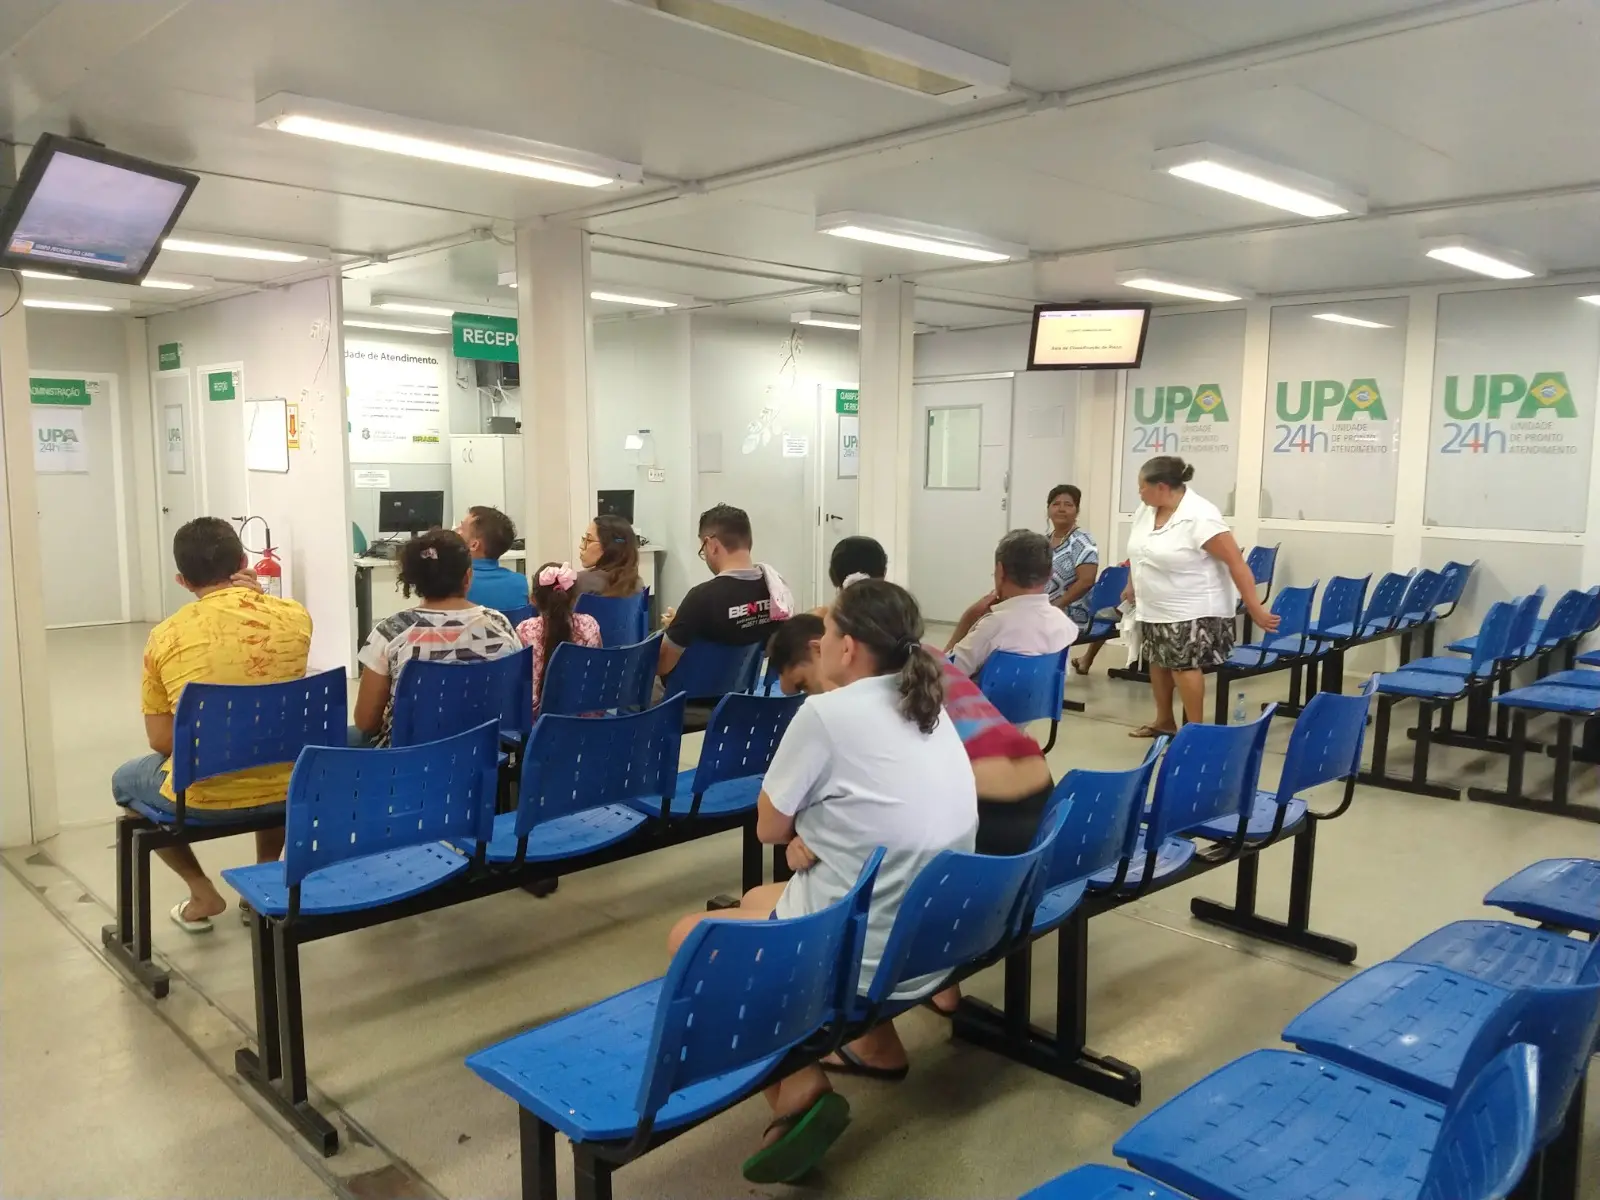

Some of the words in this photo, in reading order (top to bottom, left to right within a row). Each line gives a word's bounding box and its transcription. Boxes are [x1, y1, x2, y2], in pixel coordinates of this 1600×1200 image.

[463, 328, 519, 346] RECEP
[367, 351, 379, 360] de
[380, 352, 439, 365] Atendimento.
[1276, 378, 1388, 422] UPA
[1443, 371, 1579, 420] UPA
[1134, 383, 1229, 425] UPA
[1331, 423, 1368, 432] UNIDADE
[1510, 421, 1553, 430] UNIDADE
[38, 428, 79, 442] UPA
[843, 435, 858, 448] UP
[1132, 426, 1179, 453] 24h
[1273, 424, 1329, 453] 24h
[1331, 434, 1341, 442] DE
[1343, 434, 1376, 442] PRONTO
[1440, 422, 1507, 454] 24h
[1510, 433, 1522, 442] DE
[1524, 433, 1564, 442] PRONTO
[1330, 445, 1388, 453] ATENDIMENTO
[1508, 445, 1578, 454] ATENDIMENTO
